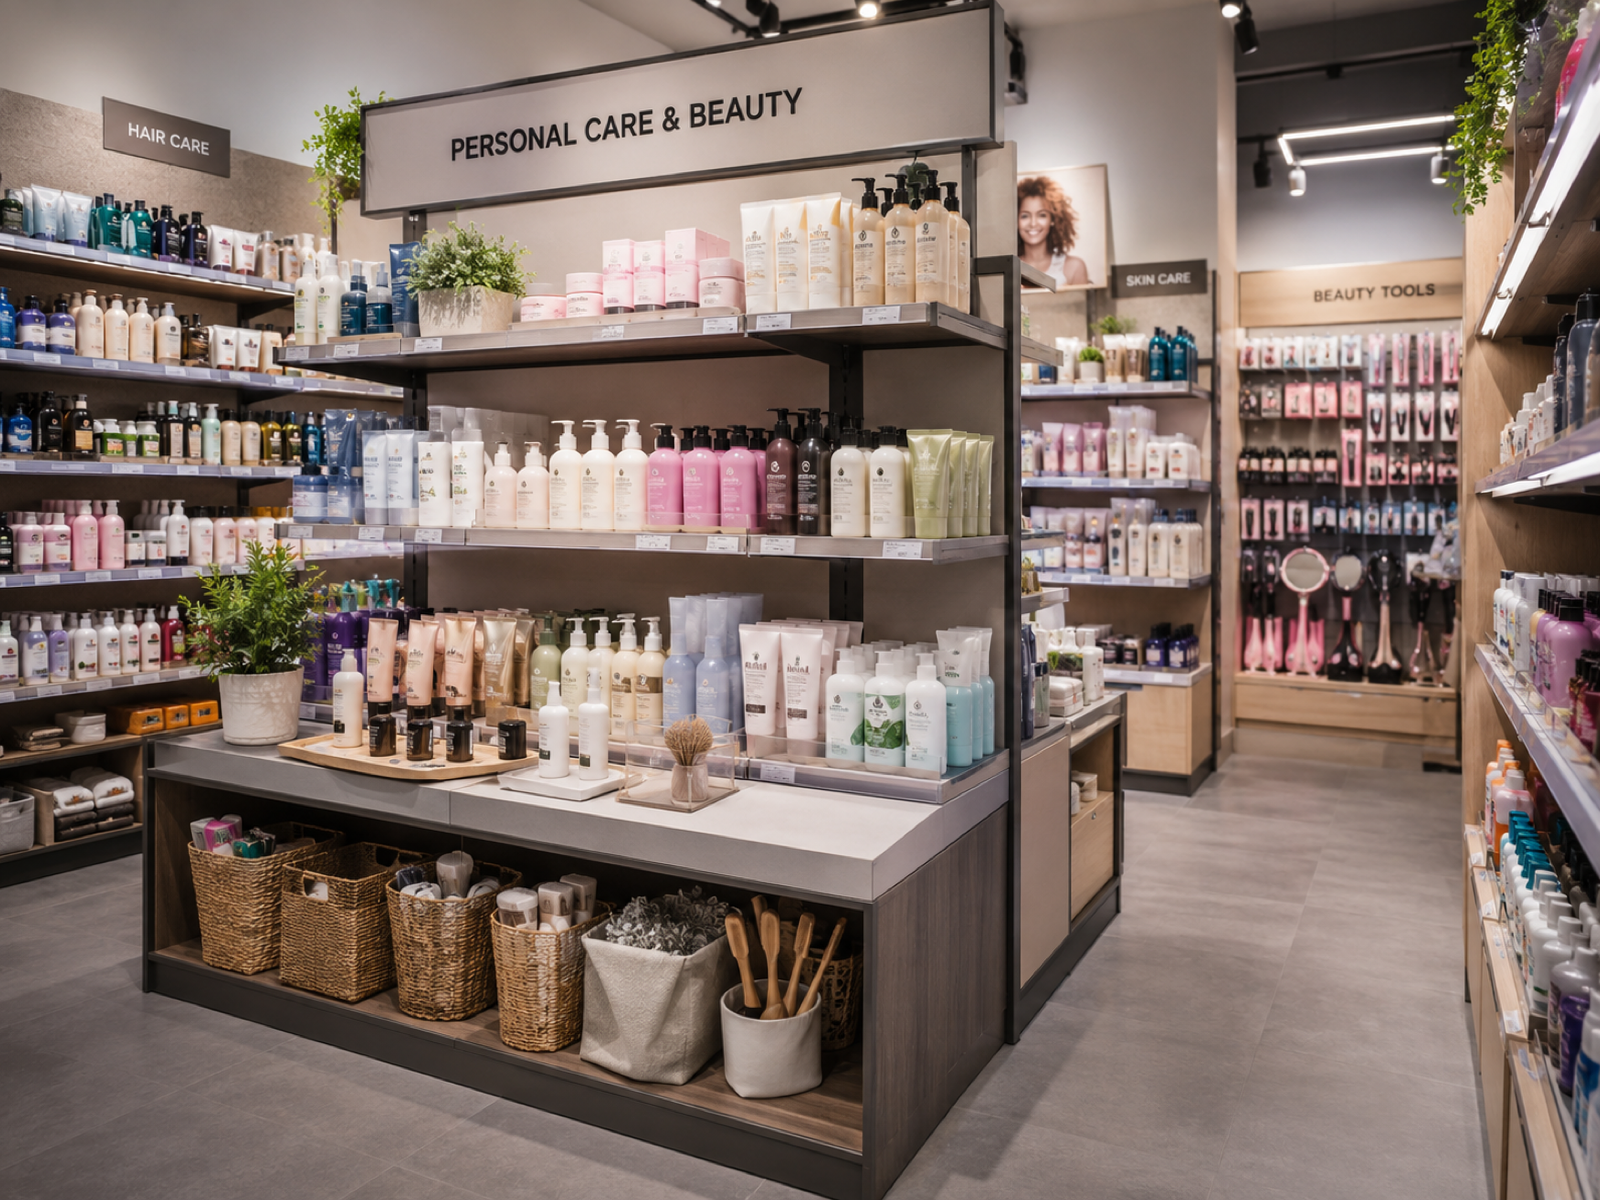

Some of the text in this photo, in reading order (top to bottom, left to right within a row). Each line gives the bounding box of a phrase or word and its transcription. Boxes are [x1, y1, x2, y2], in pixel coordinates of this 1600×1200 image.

[451, 87, 803, 161] PERSONAL CARE & BEAUTY
[128, 122, 210, 156] HAIR CARE
[1126, 271, 1192, 287] SKIN CARE
[1313, 283, 1435, 302] BEAUTY TOOLS
